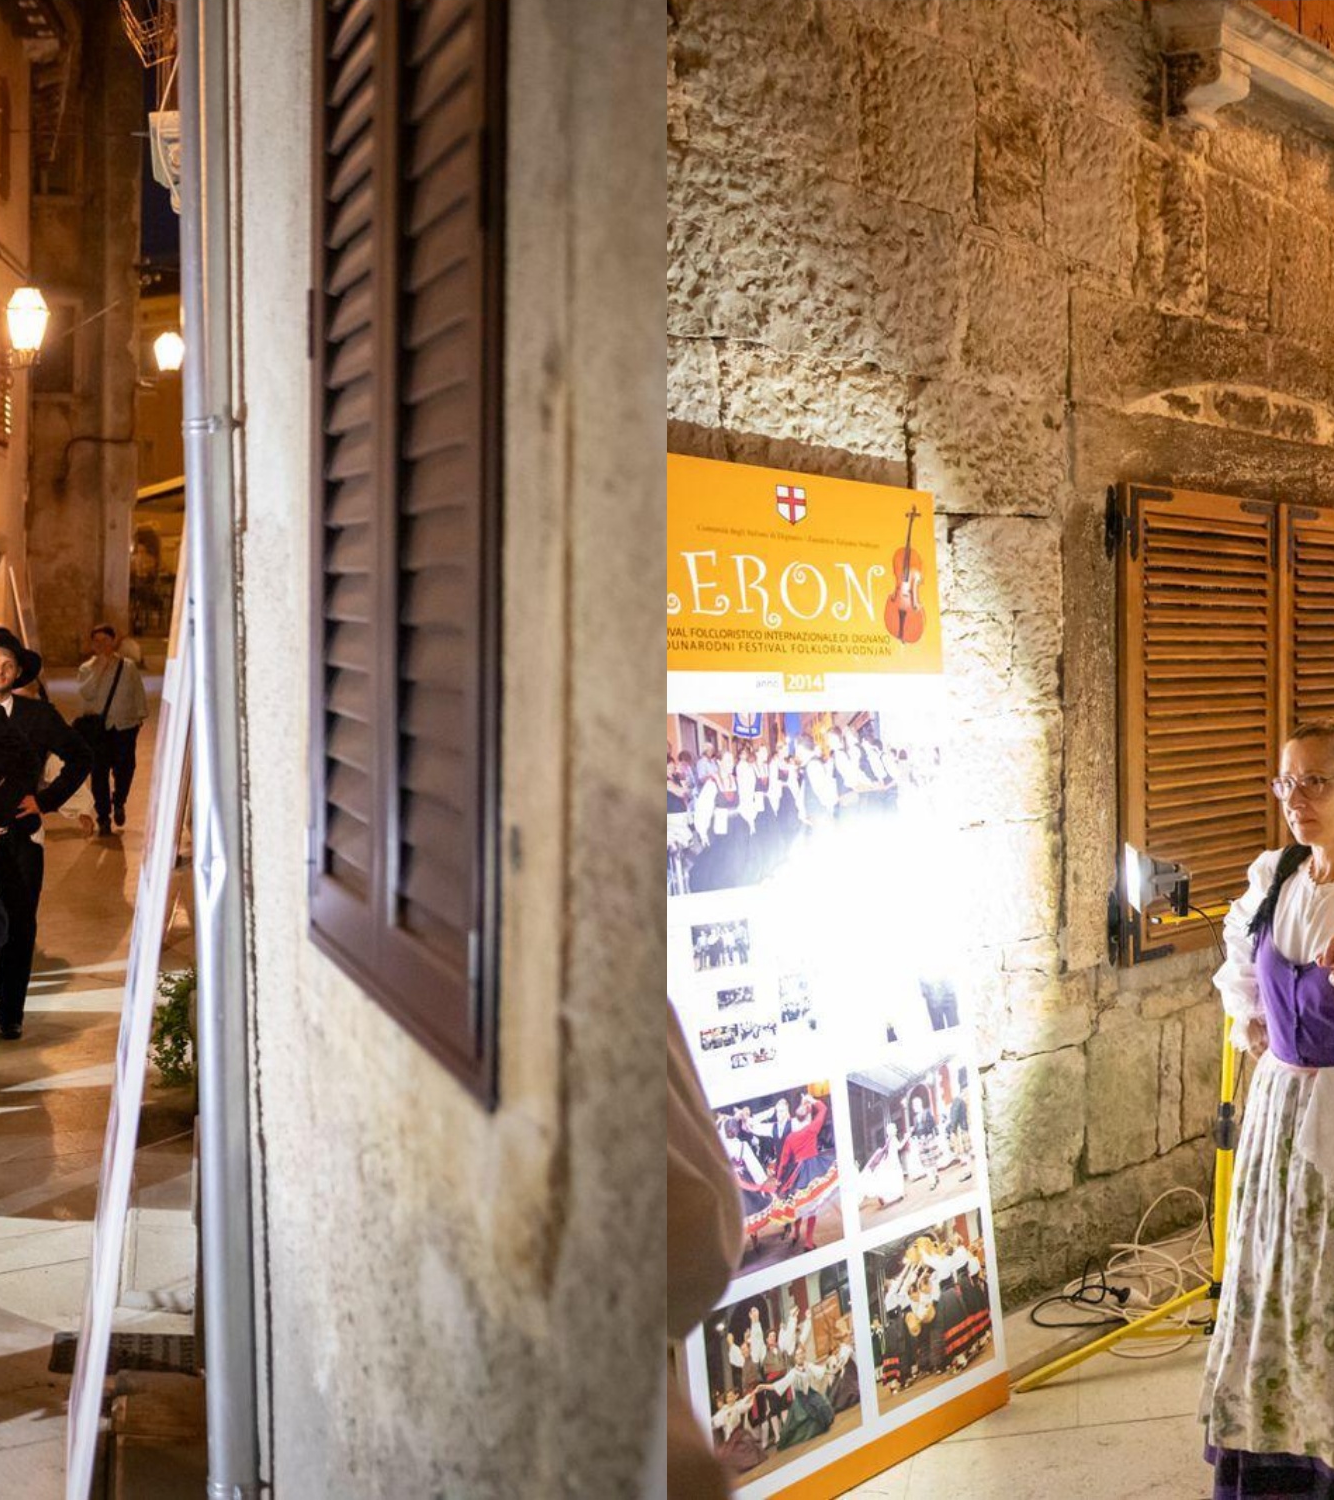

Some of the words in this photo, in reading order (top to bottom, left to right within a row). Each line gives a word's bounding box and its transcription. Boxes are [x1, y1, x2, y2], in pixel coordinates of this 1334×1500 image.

[667, 550, 885, 629] ERON
[690, 627, 762, 640] FOLCLORISTICO
[764, 630, 837, 643] INTERNAZIONALE
[852, 634, 891, 645] DIGNANO
[739, 642, 787, 654] FESTIVAL
[791, 643, 843, 655] FOLKLORA
[847, 645, 892, 657] VODNJAN
[787, 673, 823, 690] 2014
